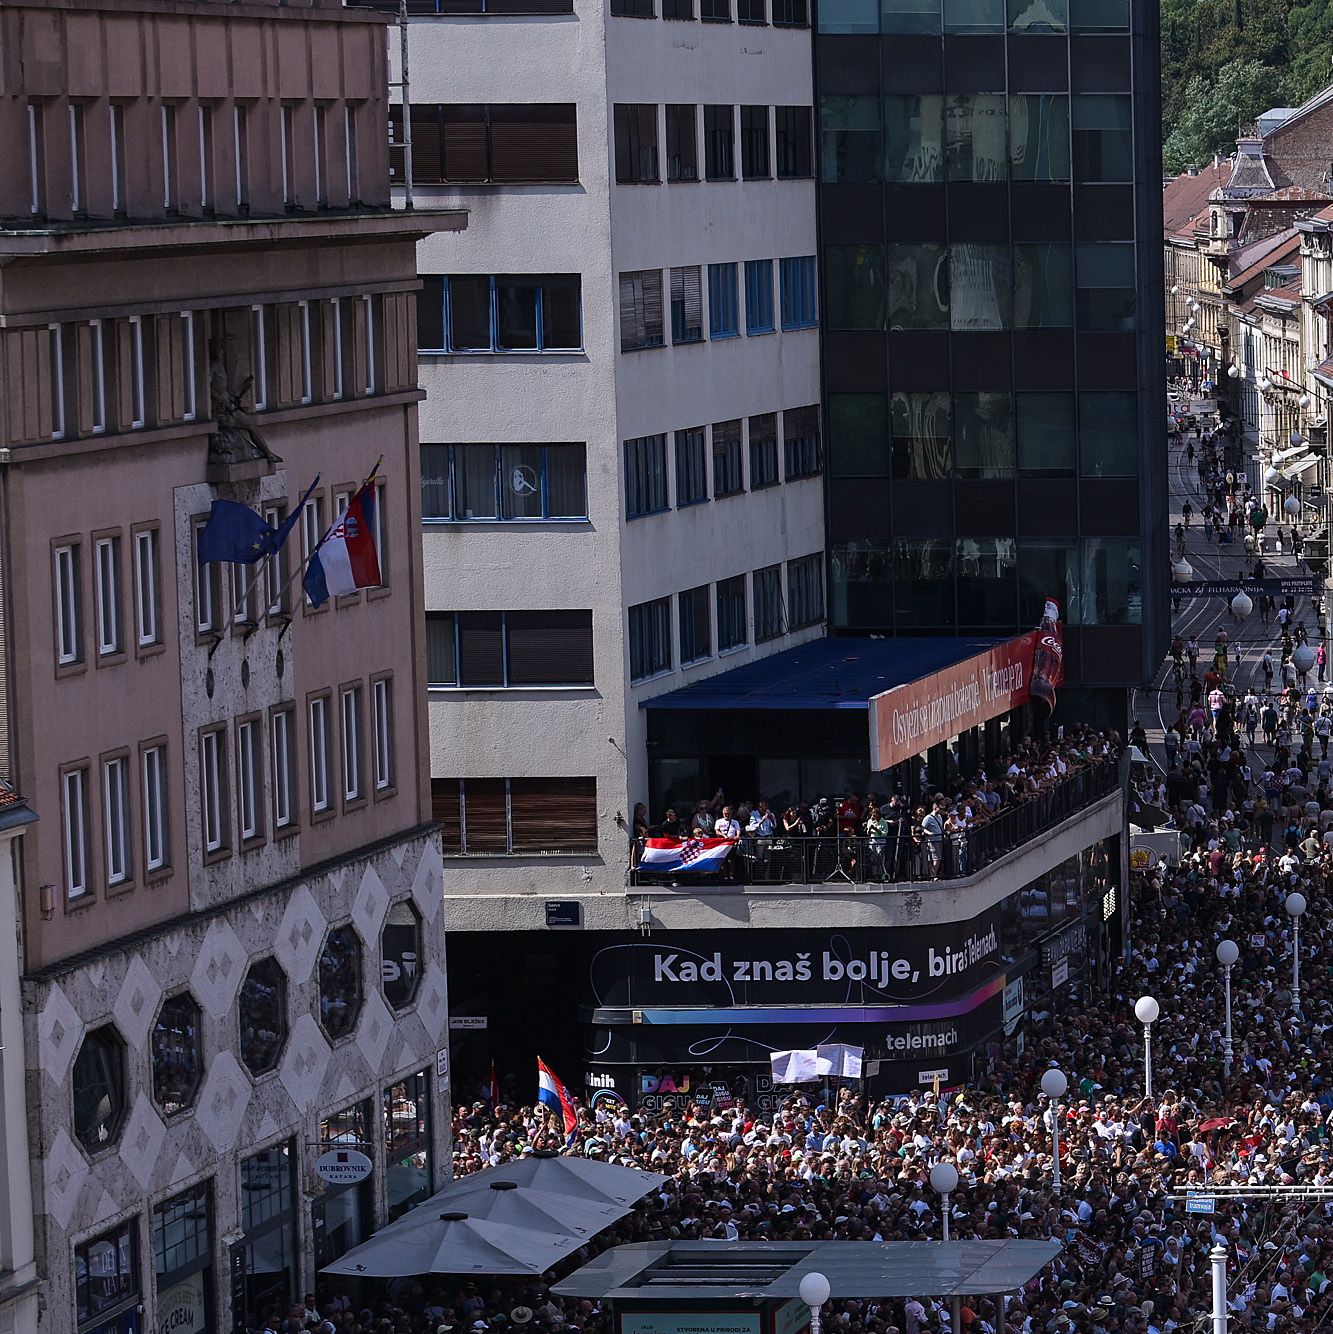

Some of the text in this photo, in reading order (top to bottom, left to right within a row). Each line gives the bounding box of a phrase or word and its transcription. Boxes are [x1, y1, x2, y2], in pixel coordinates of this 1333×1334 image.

[653, 952, 722, 982] Kad
[733, 953, 812, 982] znaš
[823, 951, 921, 989] bolje,
[928, 940, 968, 978] biraš
[886, 1027, 958, 1052] telemach
[641, 1075, 690, 1093] DAJ
[319, 1164, 368, 1174] DUBROVNIK
[169, 1308, 195, 1332] CREAM
